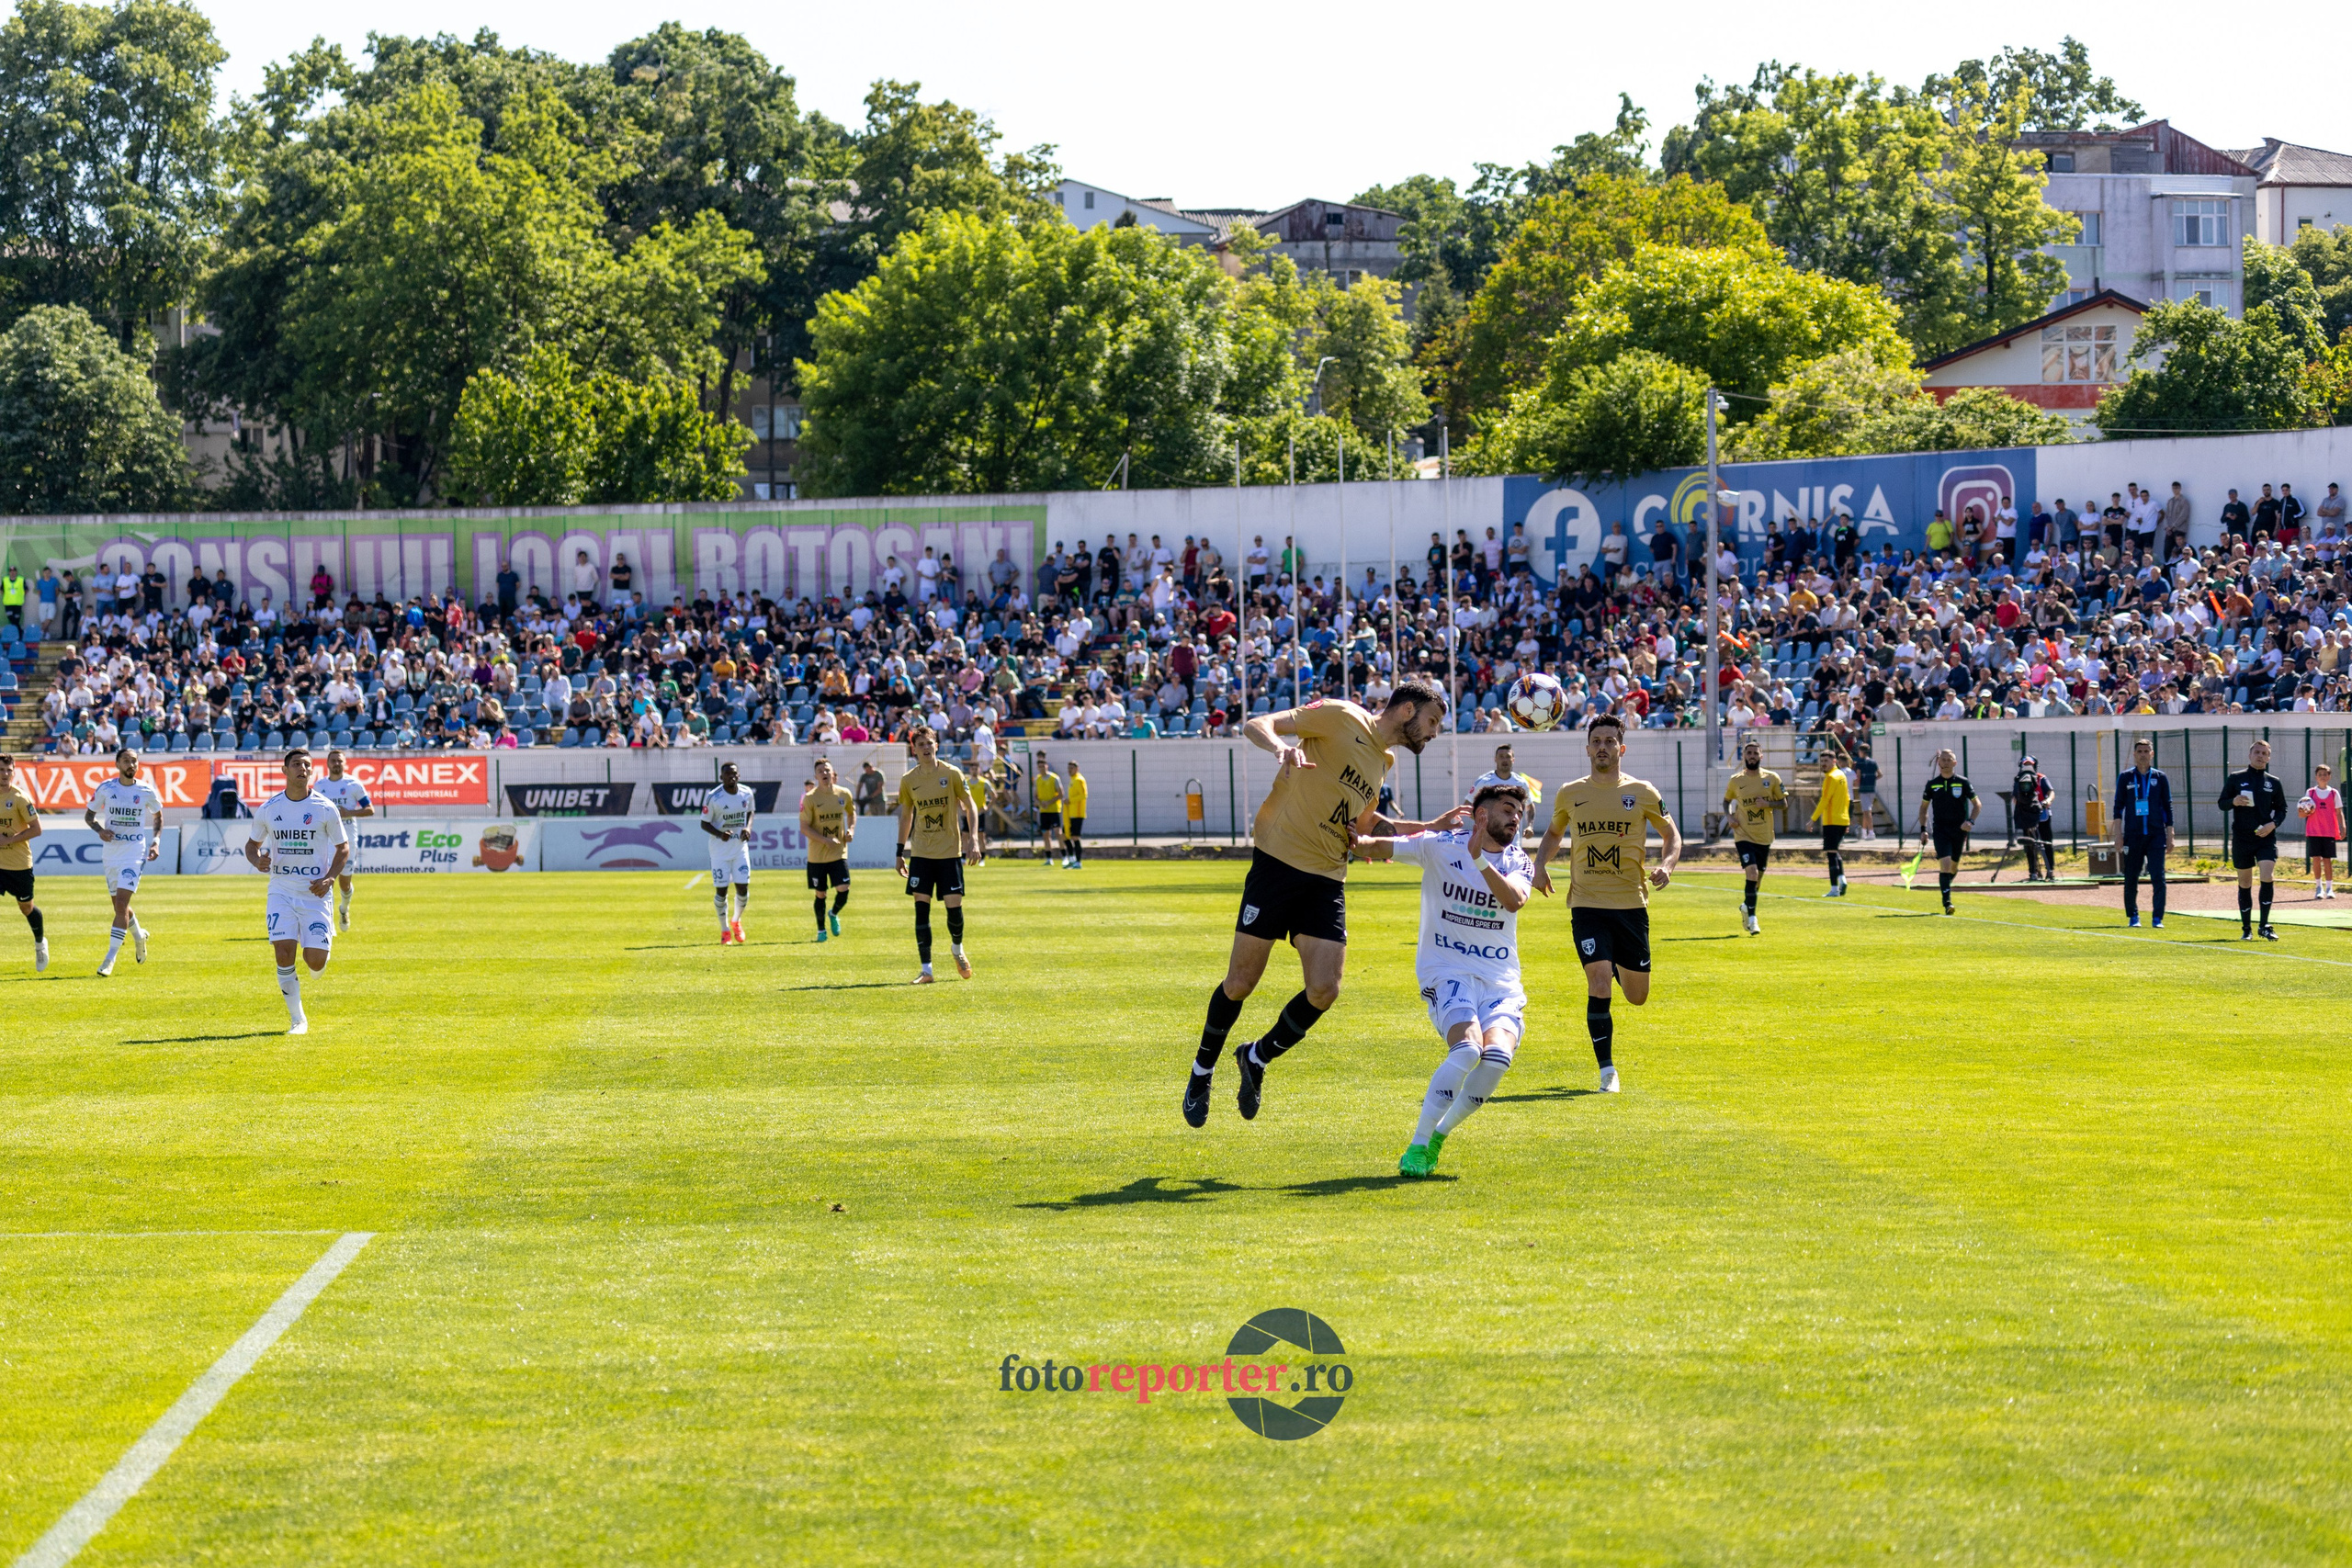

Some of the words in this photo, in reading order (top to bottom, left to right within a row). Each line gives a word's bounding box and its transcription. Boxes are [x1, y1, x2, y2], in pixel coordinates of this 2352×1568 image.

[403, 789, 458, 797] INDUSTRIALE
[525, 788, 610, 808] UNIBET
[916, 796, 949, 807] MAXBET
[108, 807, 142, 816] UNIBET
[273, 829, 316, 840] UNIBET
[1577, 820, 1632, 835] MAXBET
[416, 830, 462, 848] Eco
[419, 850, 458, 863] Plus
[1442, 881, 1504, 909] UNIBE
[266, 912, 280, 931] 27
[1475, 919, 1491, 929] SPRE
[1434, 932, 1509, 960] ELSACO
[1447, 979, 1460, 998] 7
